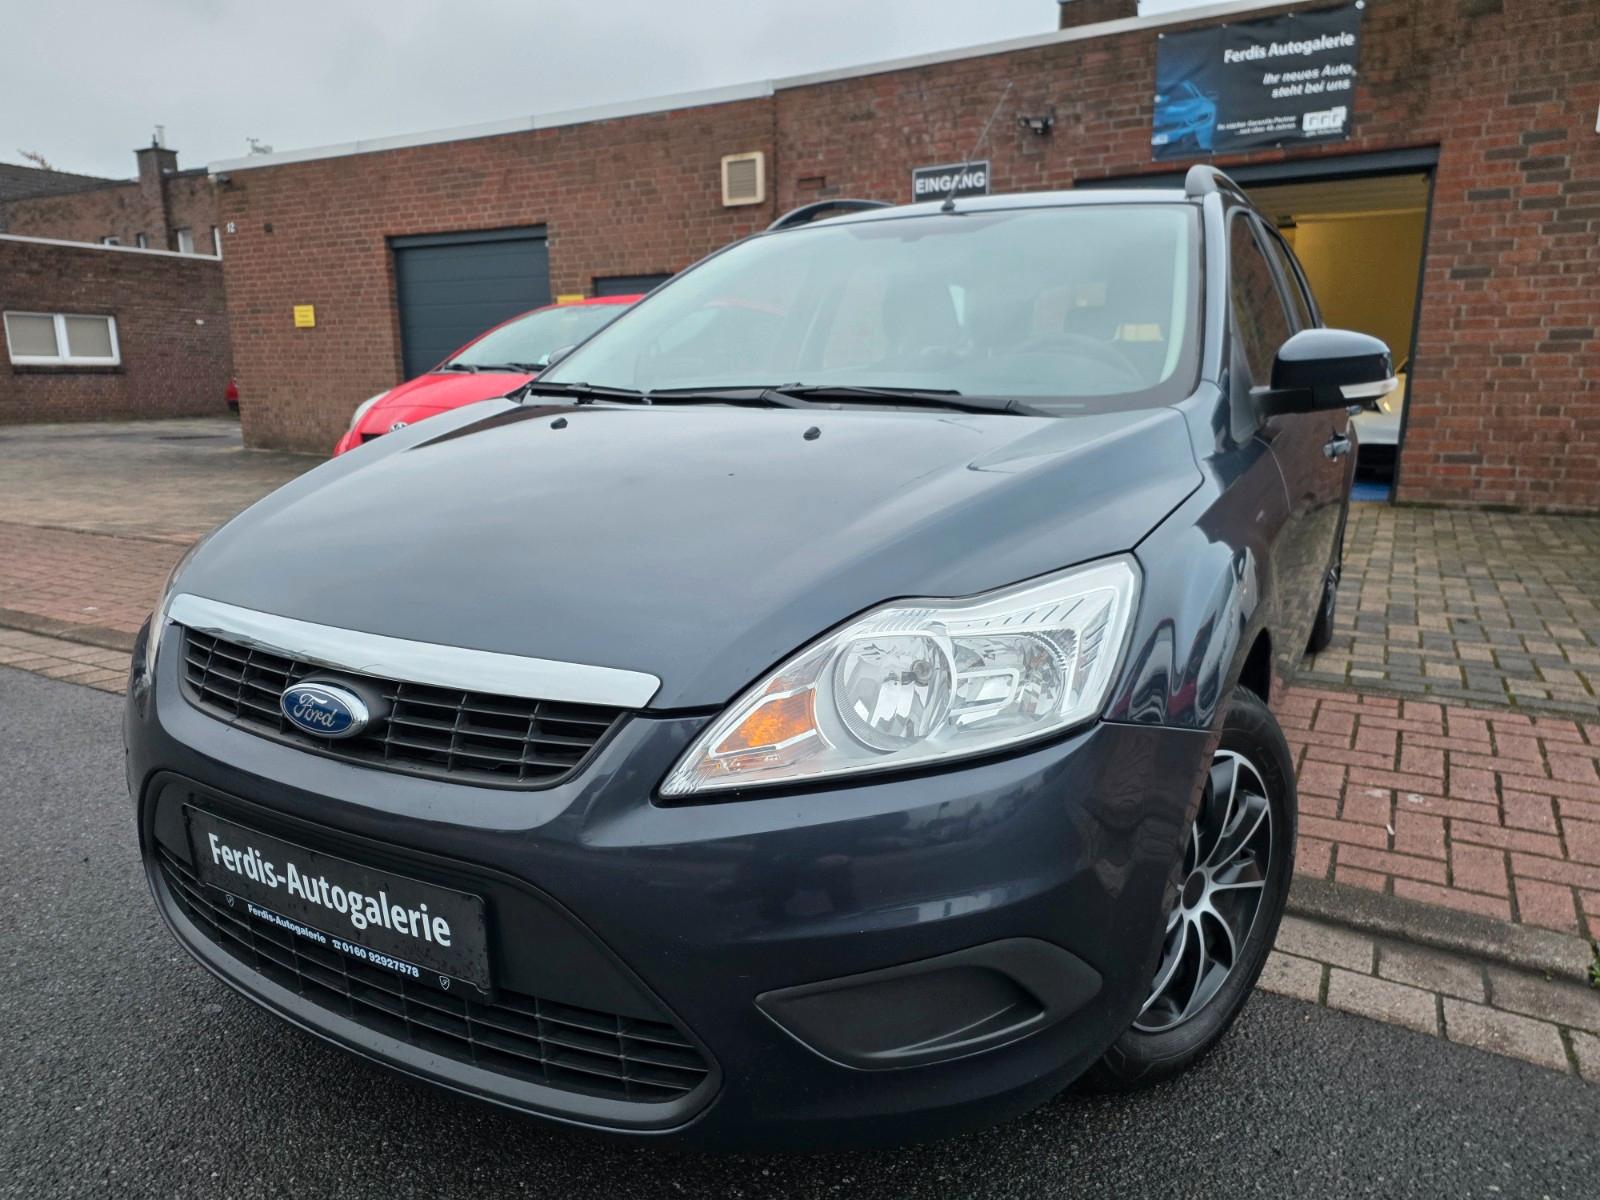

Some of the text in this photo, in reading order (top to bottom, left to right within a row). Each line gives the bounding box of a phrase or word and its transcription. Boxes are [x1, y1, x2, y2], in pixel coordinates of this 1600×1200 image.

[1223, 31, 1355, 63] Ferdis Autogalerie
[1263, 73, 1280, 85] Ihr
[1281, 68, 1320, 82] neues
[1271, 79, 1351, 98] steht bei uns
[915, 171, 986, 194] EINGANG
[293, 693, 338, 728] Ford
[208, 832, 452, 947] Ferdis-Autogalerie
[248, 903, 420, 978] Ferdis-Autogalerie 0160 92927578
